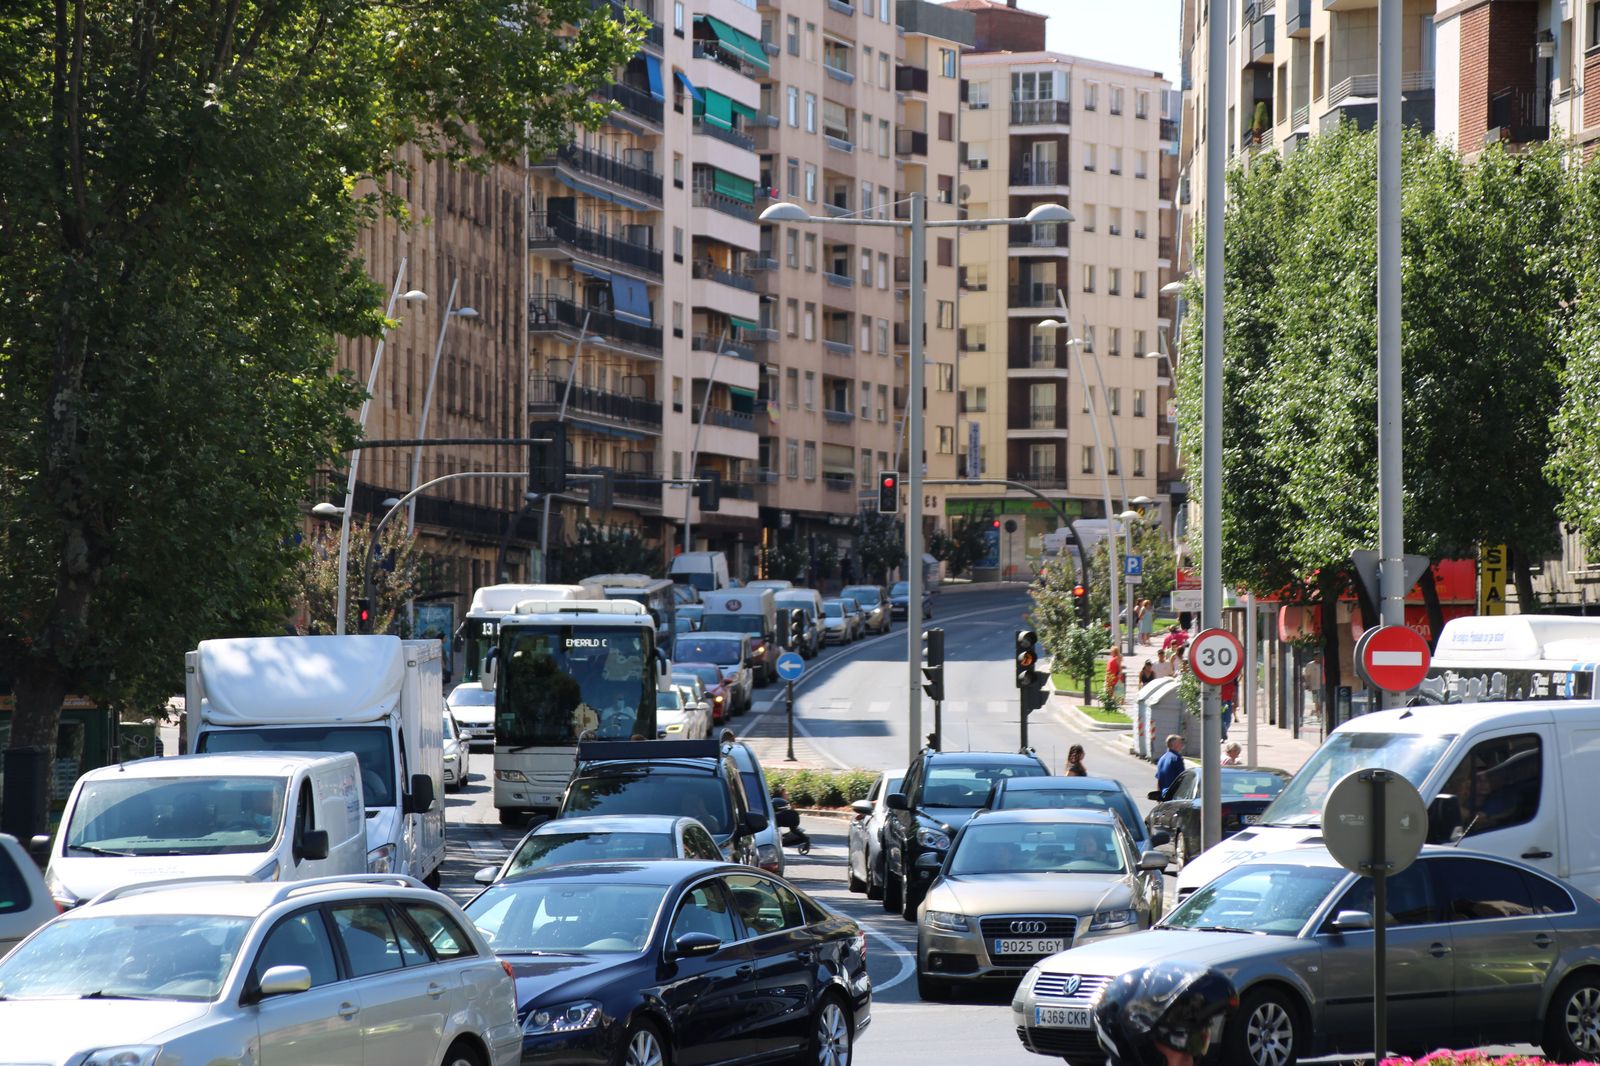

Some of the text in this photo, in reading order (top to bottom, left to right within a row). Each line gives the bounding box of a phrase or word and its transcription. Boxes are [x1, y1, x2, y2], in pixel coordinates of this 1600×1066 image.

[1127, 557, 1139, 573] P
[482, 622, 493, 636] 13
[565, 638, 599, 647] EMERALD
[1202, 648, 1232, 666] 30
[1002, 941, 1061, 952] 9025 GGY
[1041, 1008, 1088, 1025] 4369 CKR
